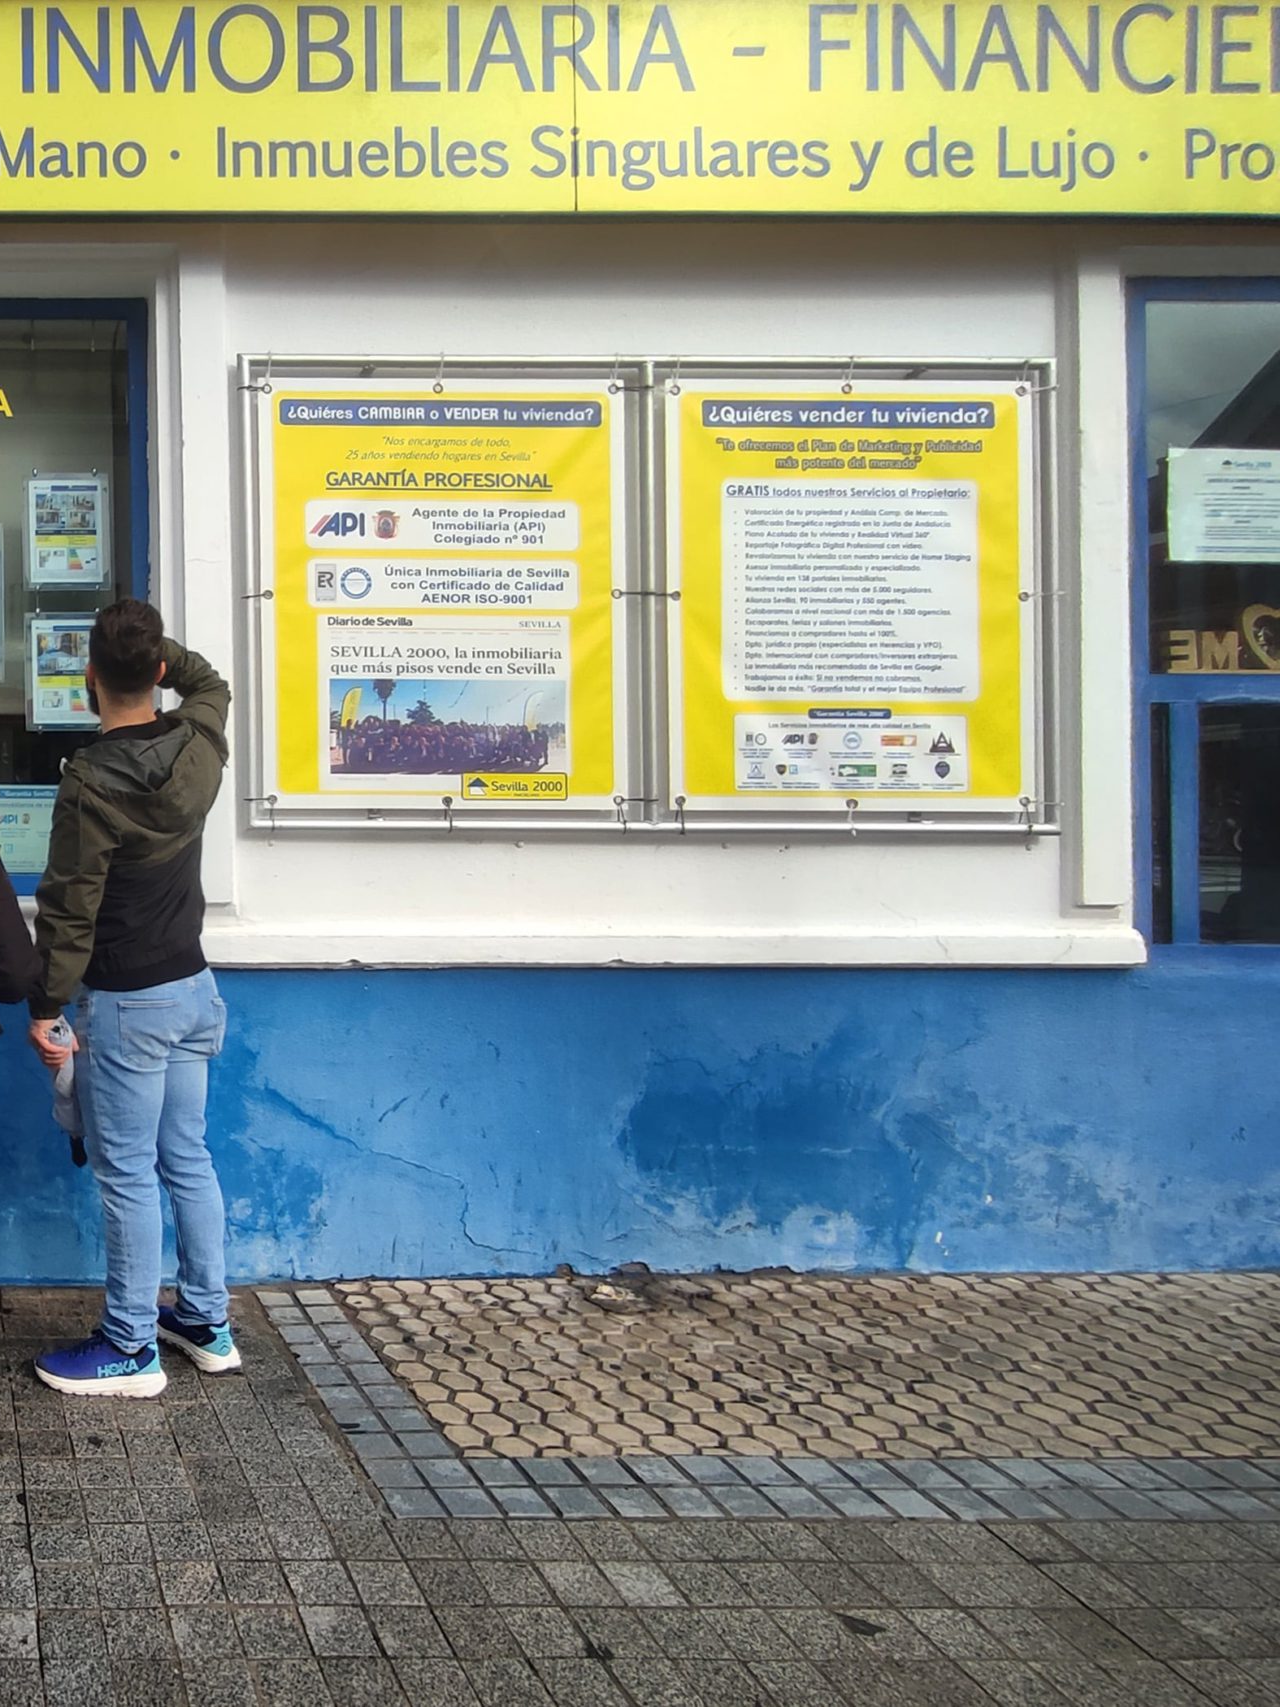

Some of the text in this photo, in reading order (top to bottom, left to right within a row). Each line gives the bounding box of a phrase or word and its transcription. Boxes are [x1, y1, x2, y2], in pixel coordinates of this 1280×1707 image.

[21, 3, 696, 94] INMOBILIARIA
[809, 4, 1280, 95] FINANCIE
[217, 126, 510, 178] Inmuebles
[529, 125, 831, 191] Singulares
[849, 138, 883, 191] y
[905, 126, 974, 178] de
[998, 126, 1115, 191] Lujo
[1184, 127, 1276, 181] Pro
[287, 405, 595, 422] ¿Quiéres CAMBIAR o VENDER tu vivienda?
[708, 405, 990, 424] ¿Quiéres vender tu vivienda?
[408, 437, 468, 448] encargamos
[470, 437, 484, 446] de
[738, 439, 794, 452] ofrecemos
[798, 439, 809, 452] el
[811, 440, 836, 452] Plan
[839, 440, 855, 452] de
[858, 440, 912, 455] Marketing
[913, 442, 923, 456] y
[926, 440, 983, 454] Publicidad
[345, 450, 359, 460] 25
[361, 450, 385, 460] años
[389, 450, 440, 460] vendiendo
[442, 451, 482, 463] hogares
[484, 453, 497, 461] en
[775, 456, 798, 469] más
[801, 457, 845, 471] potente
[848, 457, 866, 469] del
[326, 469, 553, 489] GARANTÍA PROFESIONAL
[726, 484, 971, 500] GRATIS todos nuestros Servicios al Propietario:
[412, 507, 566, 520] Agente de la Propiedad
[310, 511, 366, 537] API
[432, 521, 546, 533] Inmobiliaria (API)
[434, 533, 544, 545] Colegiado nº 901
[384, 563, 570, 578] Única Inmobiliaria de Sevilla
[391, 580, 564, 592] con Certificado de Calidad
[421, 593, 533, 605] AENOR ISO-9001
[327, 616, 413, 627] Diario de Sevilla
[519, 620, 562, 629] SEVILLA
[330, 645, 563, 660] SEVILLA 2000, la inmobiliaria
[330, 662, 556, 676] que más pisos vende en Sevilla
[491, 780, 563, 792] Sevilla 2000
[97, 1358, 139, 1378] HOKA
